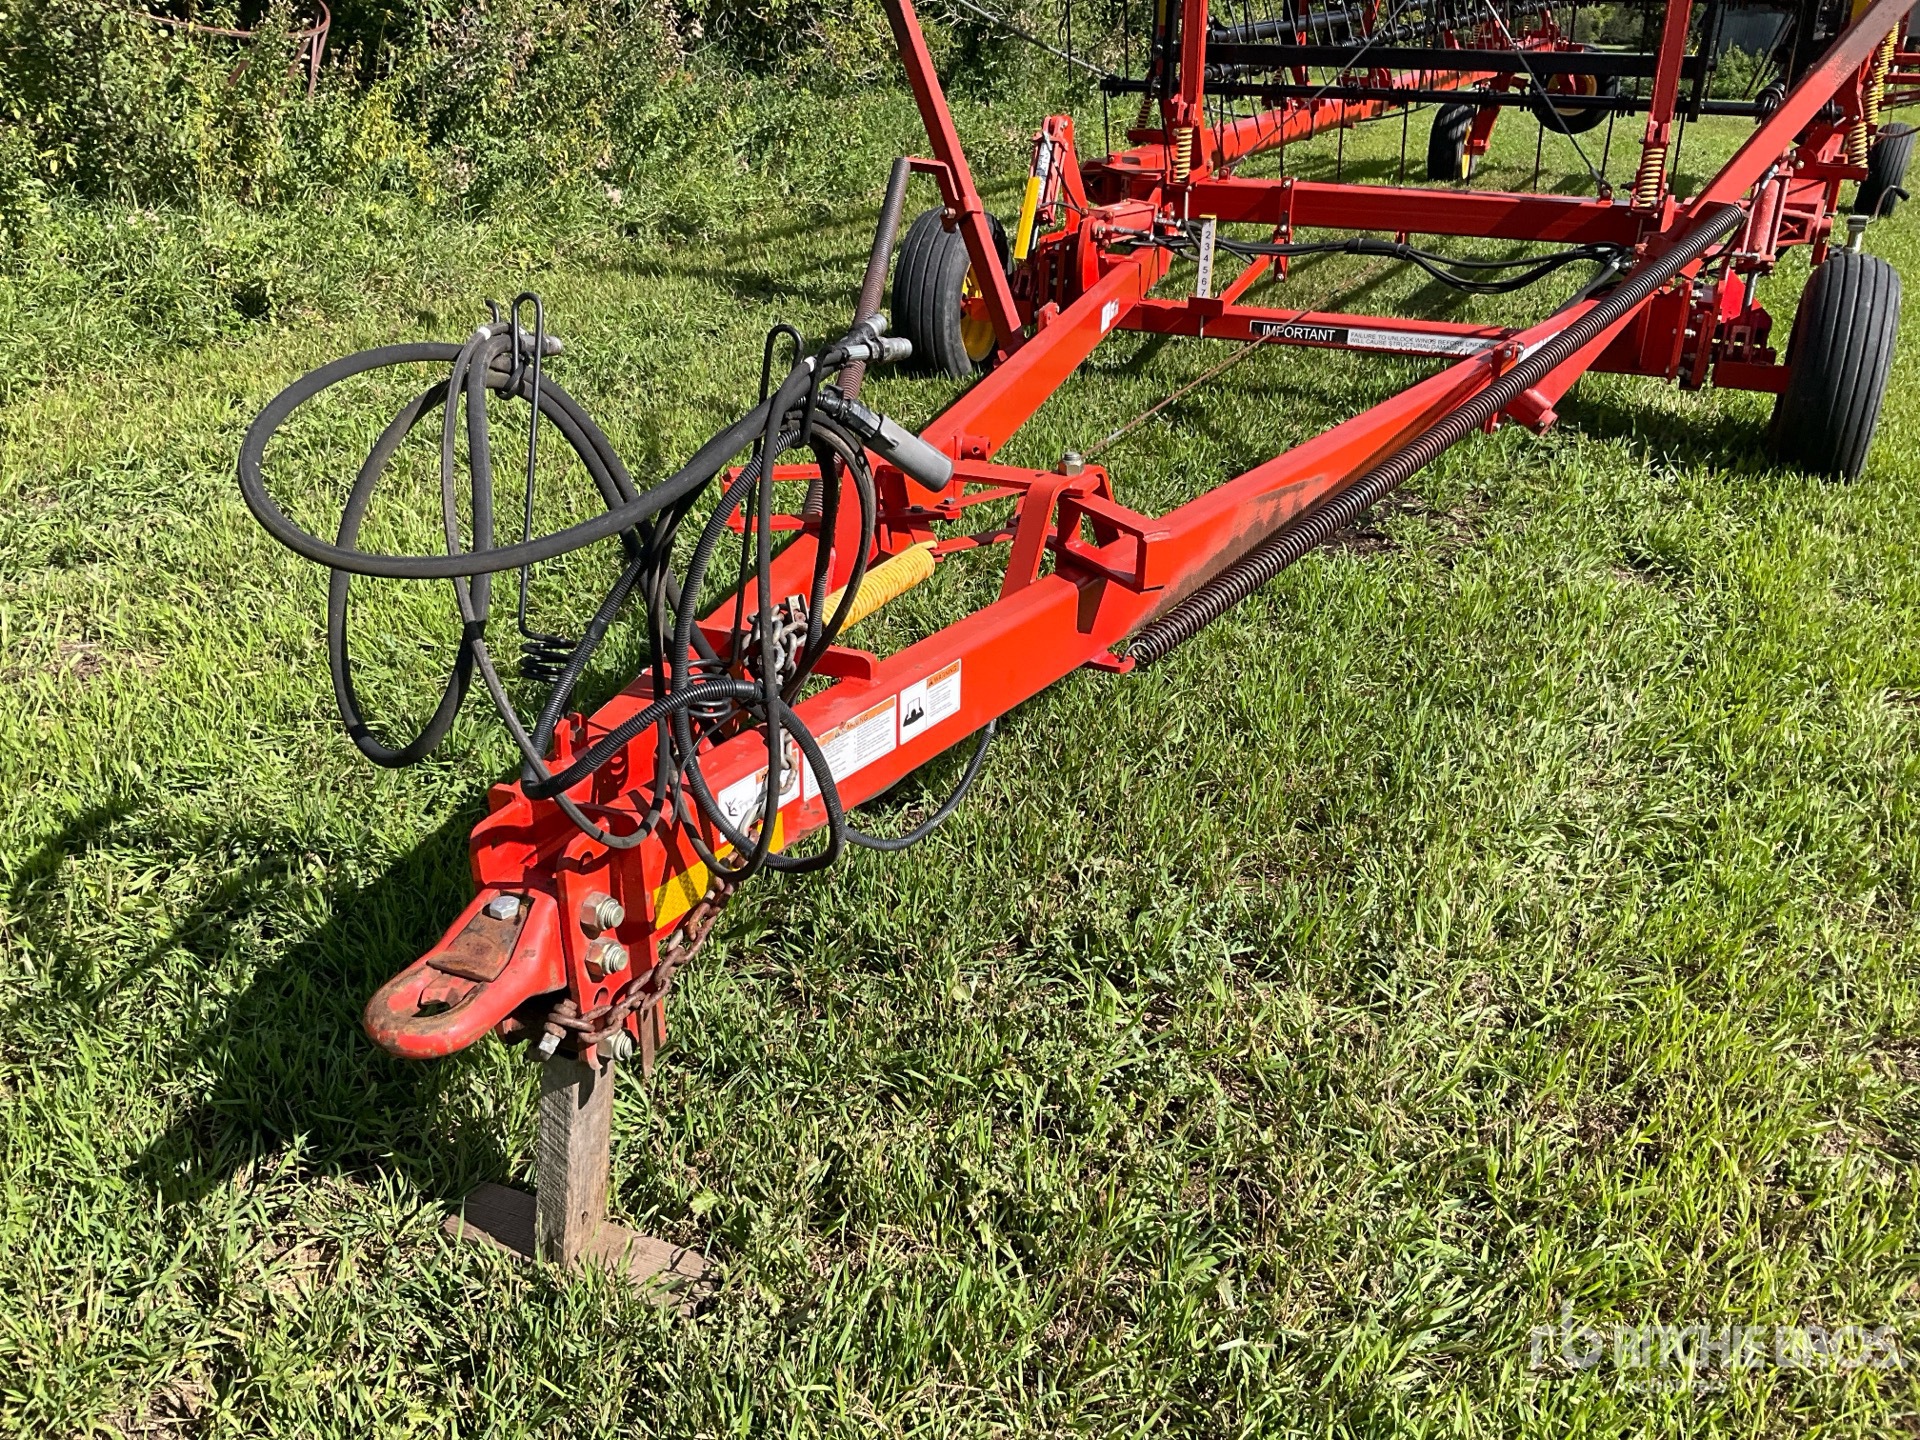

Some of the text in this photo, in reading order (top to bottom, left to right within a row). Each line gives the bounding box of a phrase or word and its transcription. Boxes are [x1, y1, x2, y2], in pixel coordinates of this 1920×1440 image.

[1205, 231, 1211, 239] 2
[1204, 243, 1210, 251] 3
[1203, 254, 1209, 262] 4
[1202, 266, 1208, 274] 5
[1201, 278, 1207, 286] 6
[1201, 289, 1206, 297] 7
[1262, 324, 1336, 341] IMPORTANT
[1349, 337, 1364, 345] WILL
[1350, 331, 1376, 340] FAILURE
[1388, 334, 1414, 343] UNLOCK
